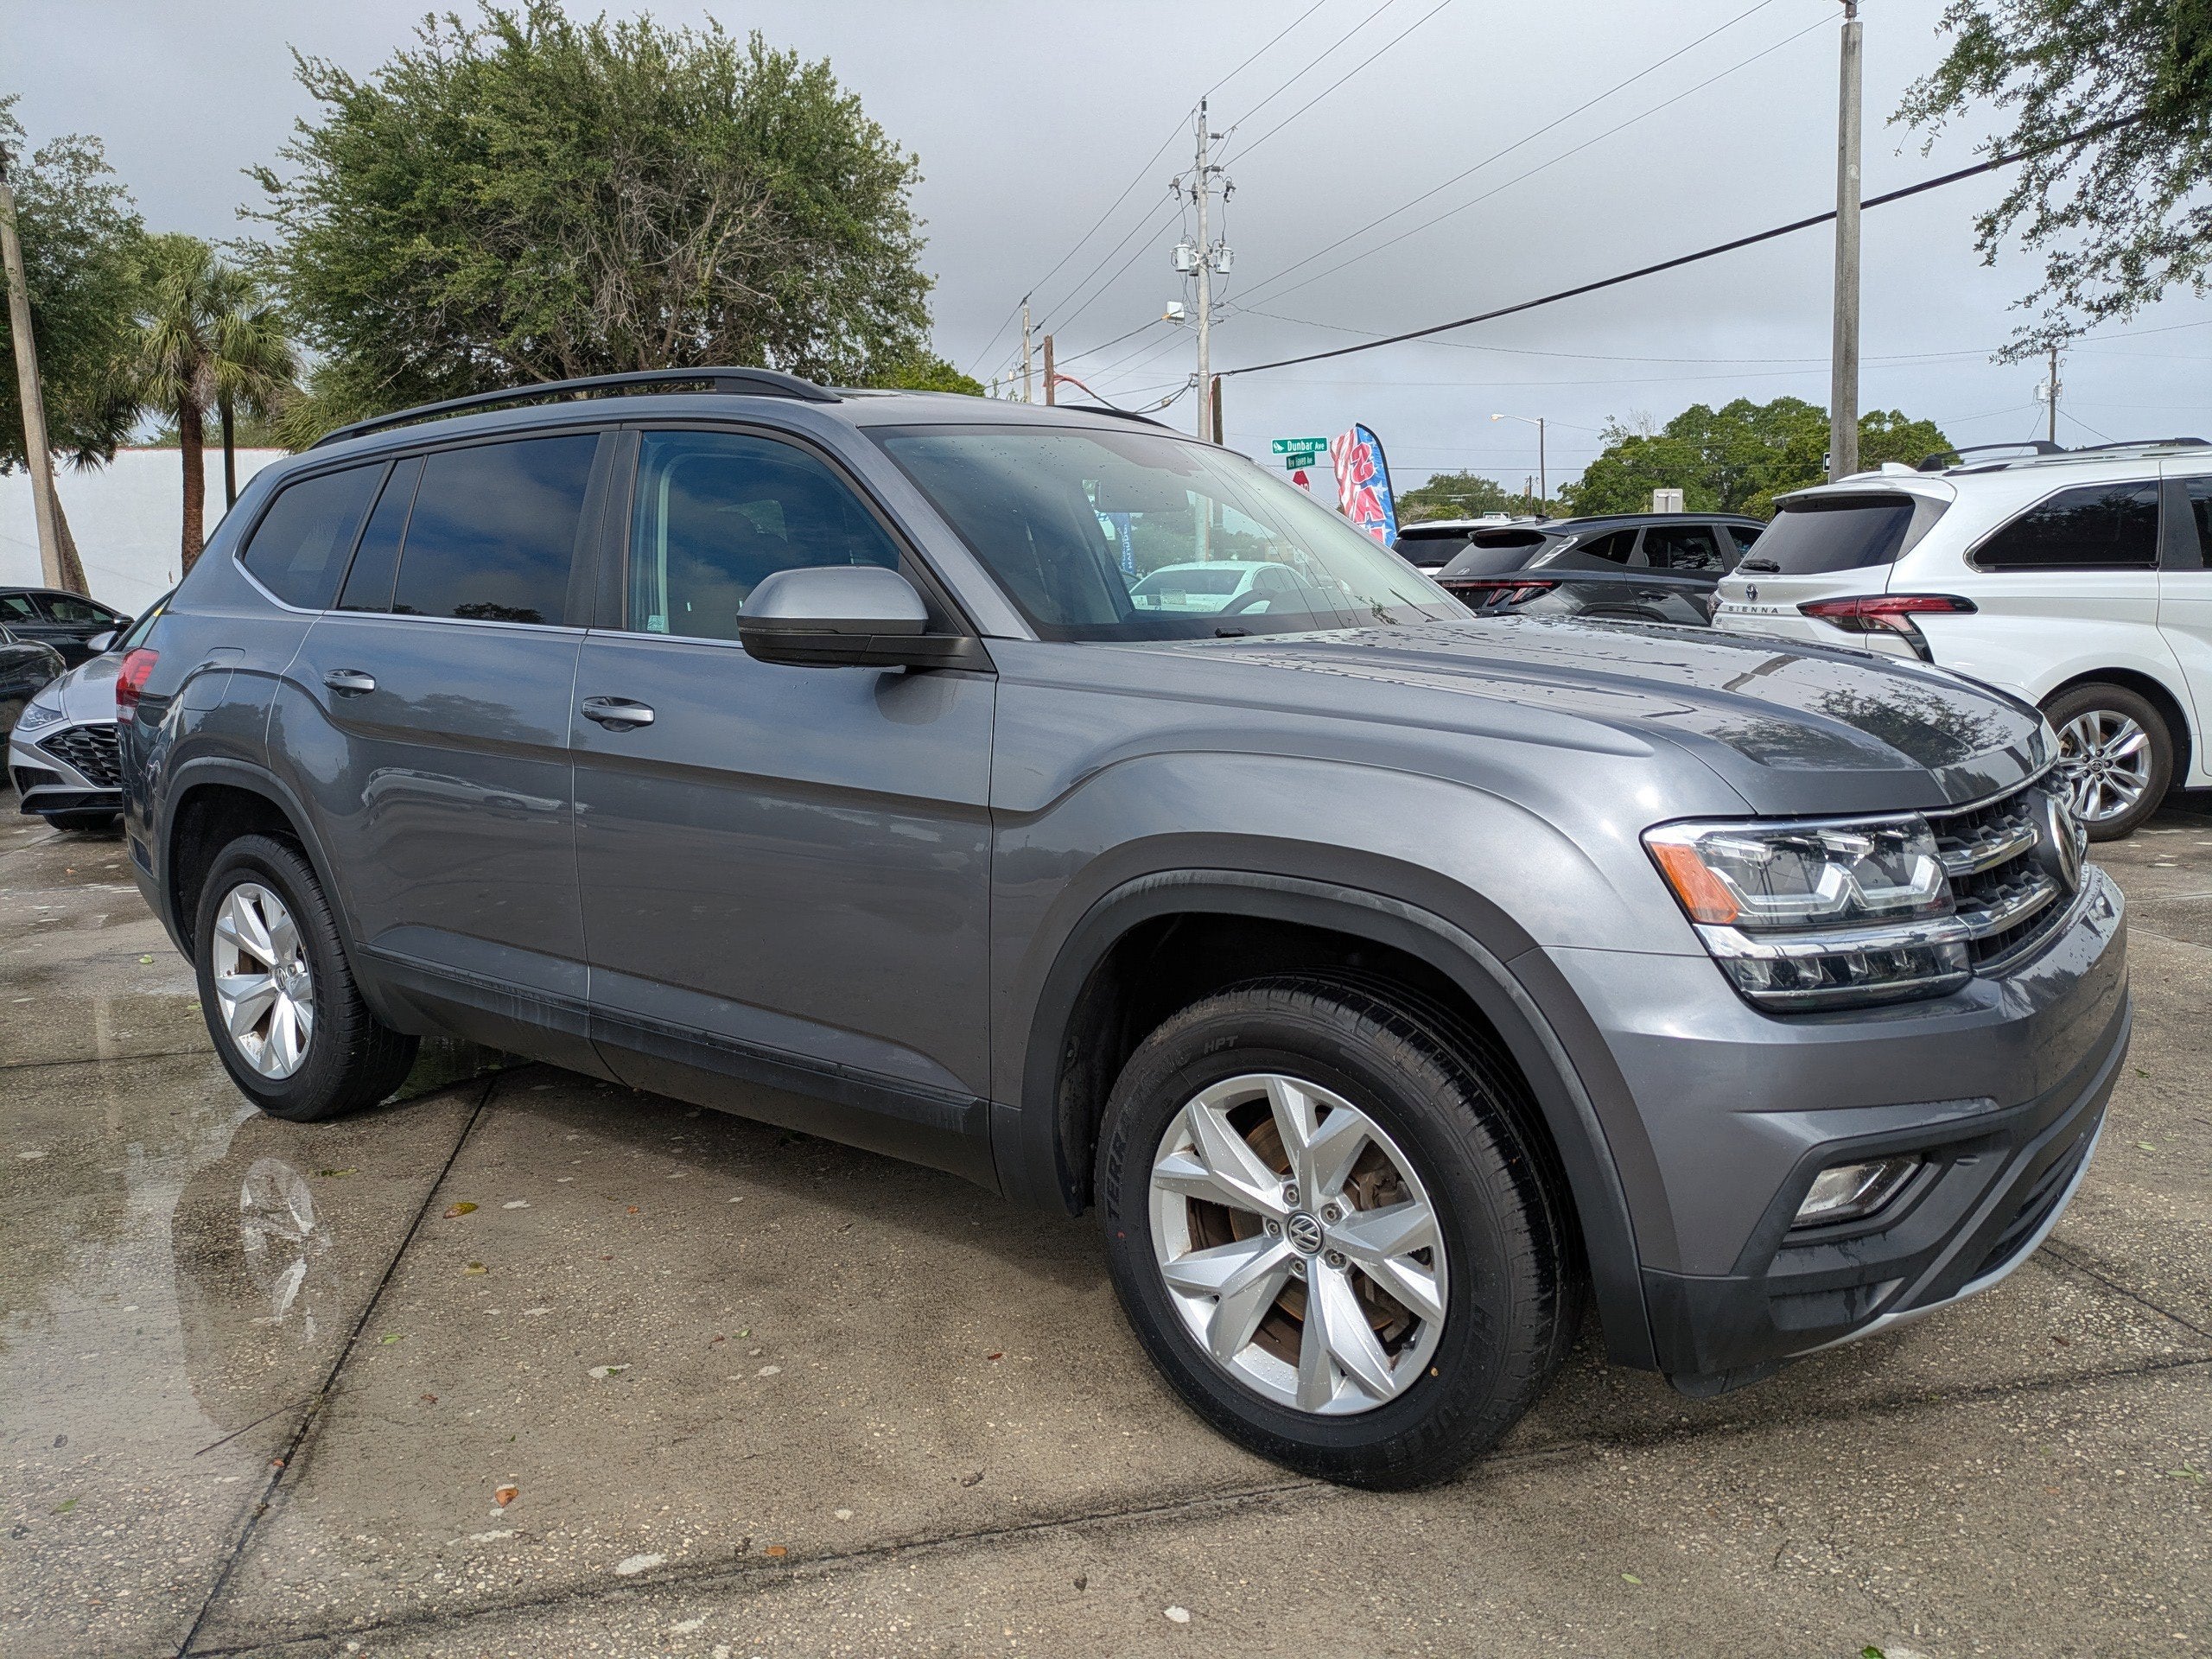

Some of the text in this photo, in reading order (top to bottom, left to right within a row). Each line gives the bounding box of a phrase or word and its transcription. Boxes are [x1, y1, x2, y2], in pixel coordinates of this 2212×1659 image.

[1287, 441, 1325, 451] Dunbar Ave
[1728, 606, 1778, 614] SIENNA
[1204, 1036, 1238, 1054] HPT
